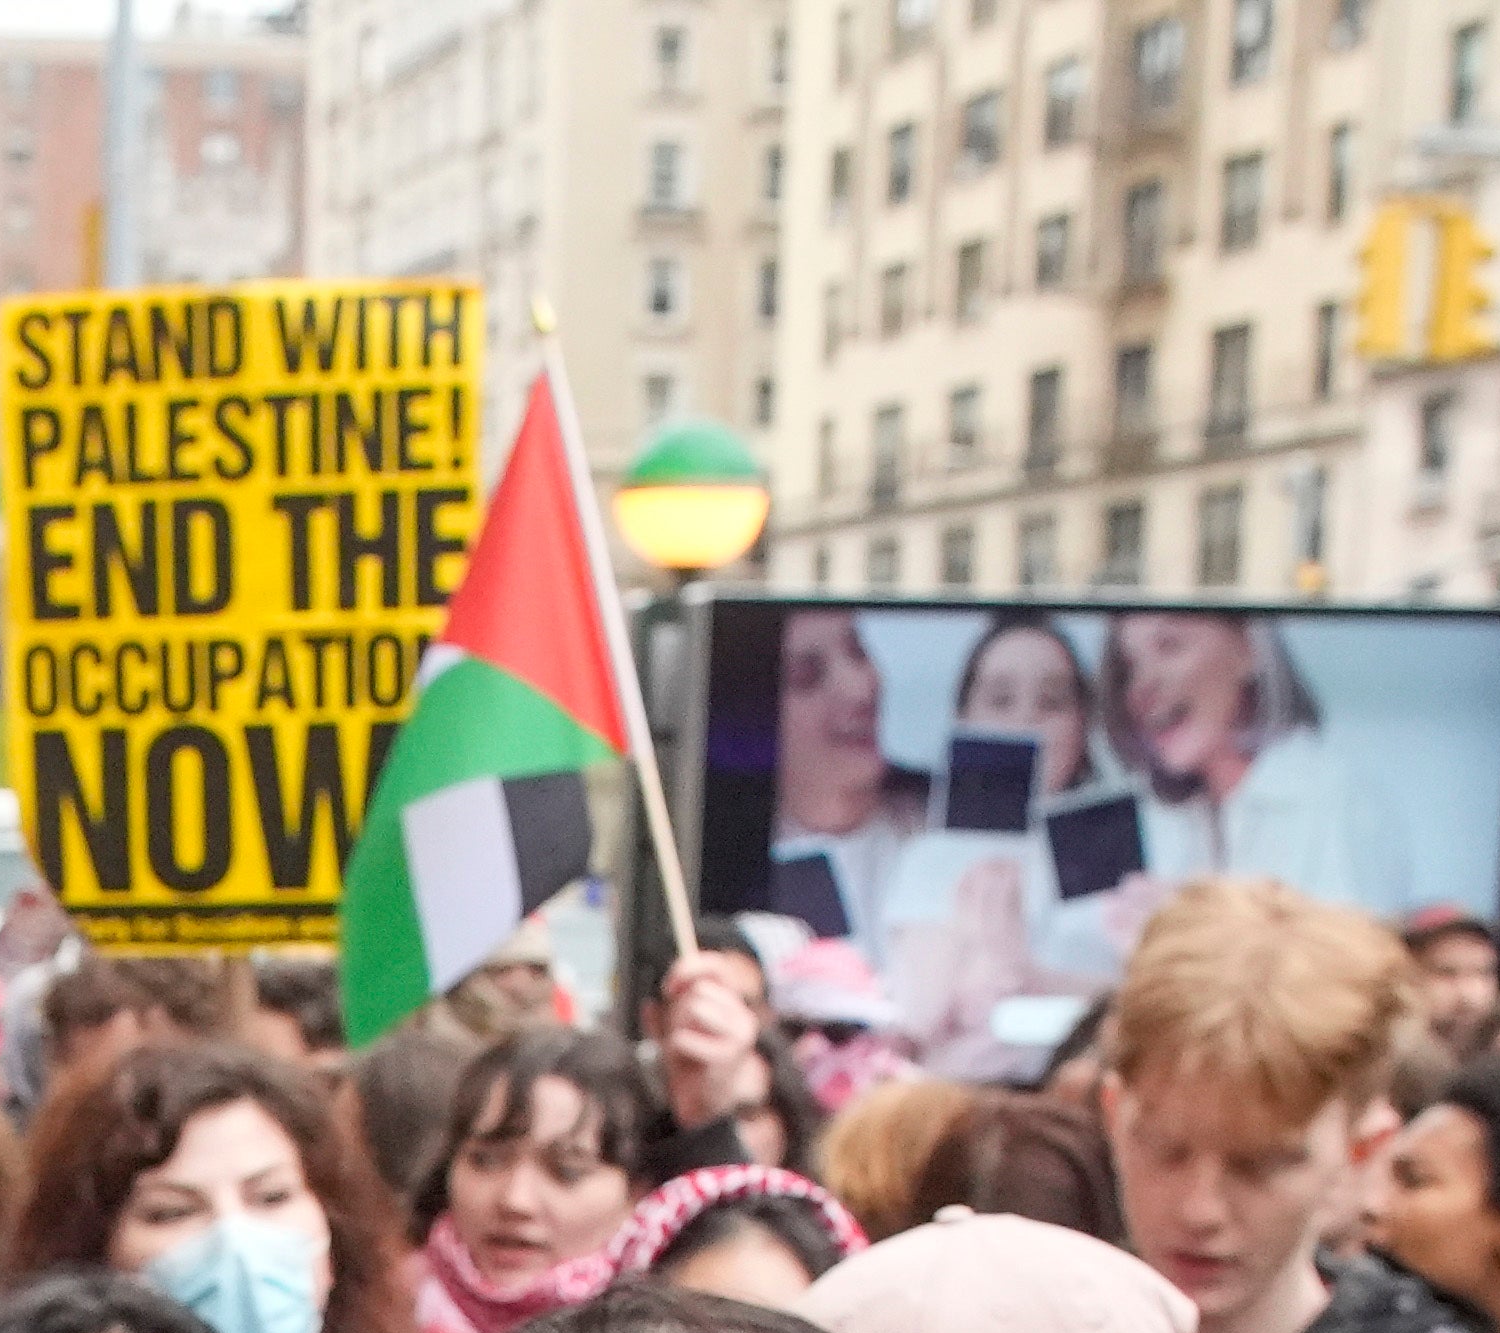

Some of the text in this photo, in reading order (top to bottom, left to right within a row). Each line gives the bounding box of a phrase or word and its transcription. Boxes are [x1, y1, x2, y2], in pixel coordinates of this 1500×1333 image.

[15, 289, 464, 391] STAND WITH
[20, 384, 464, 489] PALESTINE!
[26, 486, 470, 621] END THE
[32, 721, 403, 893] NOW
